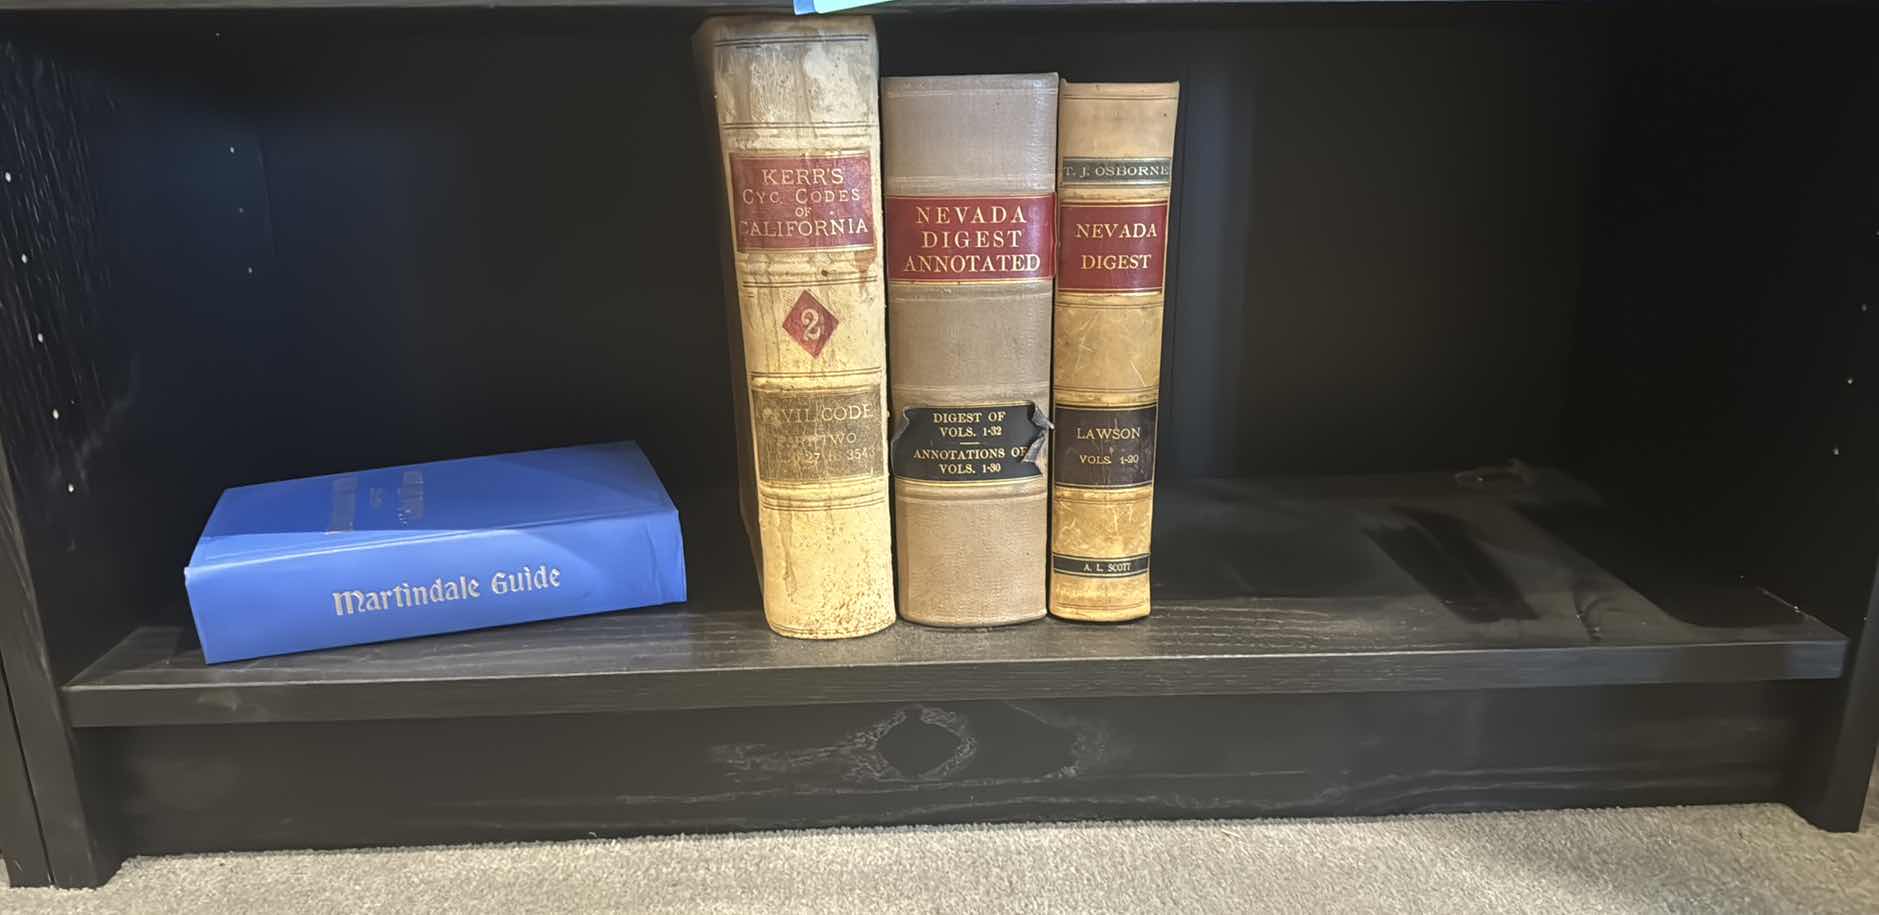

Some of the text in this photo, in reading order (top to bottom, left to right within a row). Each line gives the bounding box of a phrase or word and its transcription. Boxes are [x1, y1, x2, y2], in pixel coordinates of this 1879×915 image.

[761, 168, 844, 185] KERR'S
[1064, 165, 1169, 178] T. J. OSBORNE
[916, 205, 1027, 224] NEVADA
[1076, 223, 1157, 238] NEVADA
[922, 230, 1022, 248] DIGEST
[904, 254, 1041, 273] ANNOTATED
[1081, 254, 1152, 270] DIGEST
[801, 308, 820, 340] 2
[821, 403, 873, 421] CODE
[933, 411, 1006, 424] DIGEST OF
[940, 426, 1002, 438] VOLS. 1-32
[1076, 427, 1140, 440] LAWSON
[913, 448, 1005, 460] ANNOTATIONS
[1120, 454, 1139, 465] 1-20
[939, 463, 1001, 474] VOLS. 1-30
[1107, 562, 1132, 572] SCOTT
[332, 565, 561, 616] Martindale Guide
